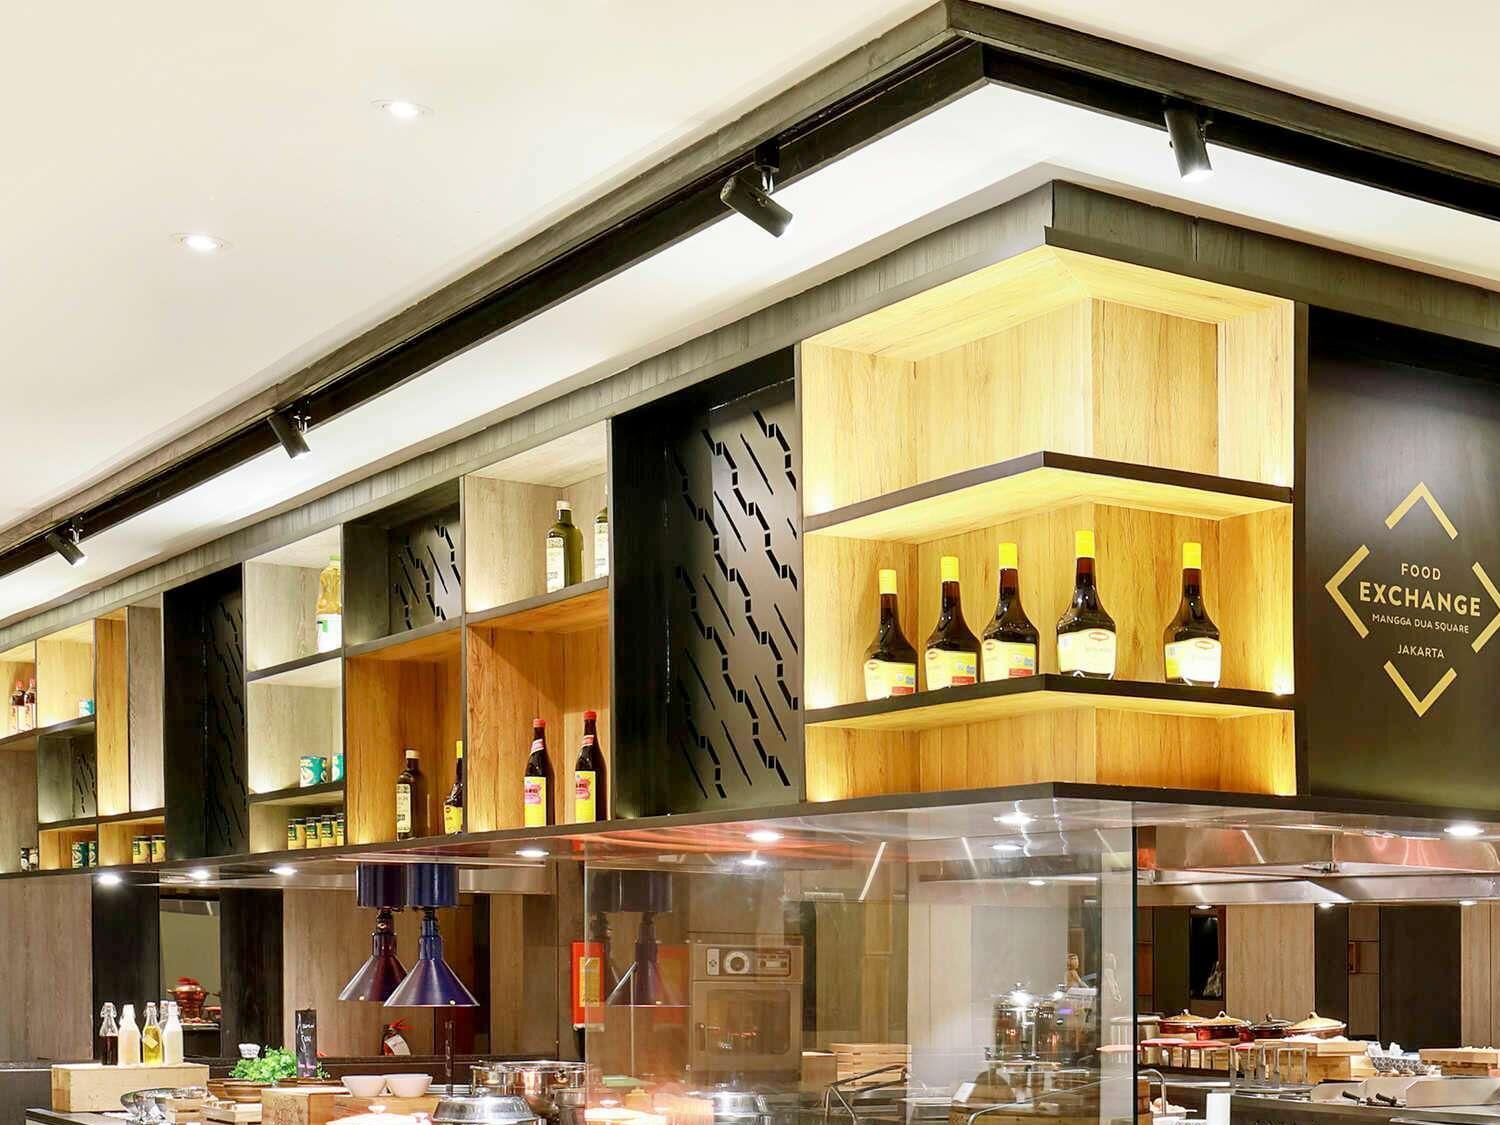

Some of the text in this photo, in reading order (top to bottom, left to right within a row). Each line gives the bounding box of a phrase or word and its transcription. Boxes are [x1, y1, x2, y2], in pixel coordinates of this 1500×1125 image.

[1401, 563, 1441, 580] FOOD
[1360, 581, 1481, 617] EXCHANGE
[1372, 613, 1469, 634] MANGGA DUA SQUARE
[1398, 644, 1445, 659] JAKARTA
